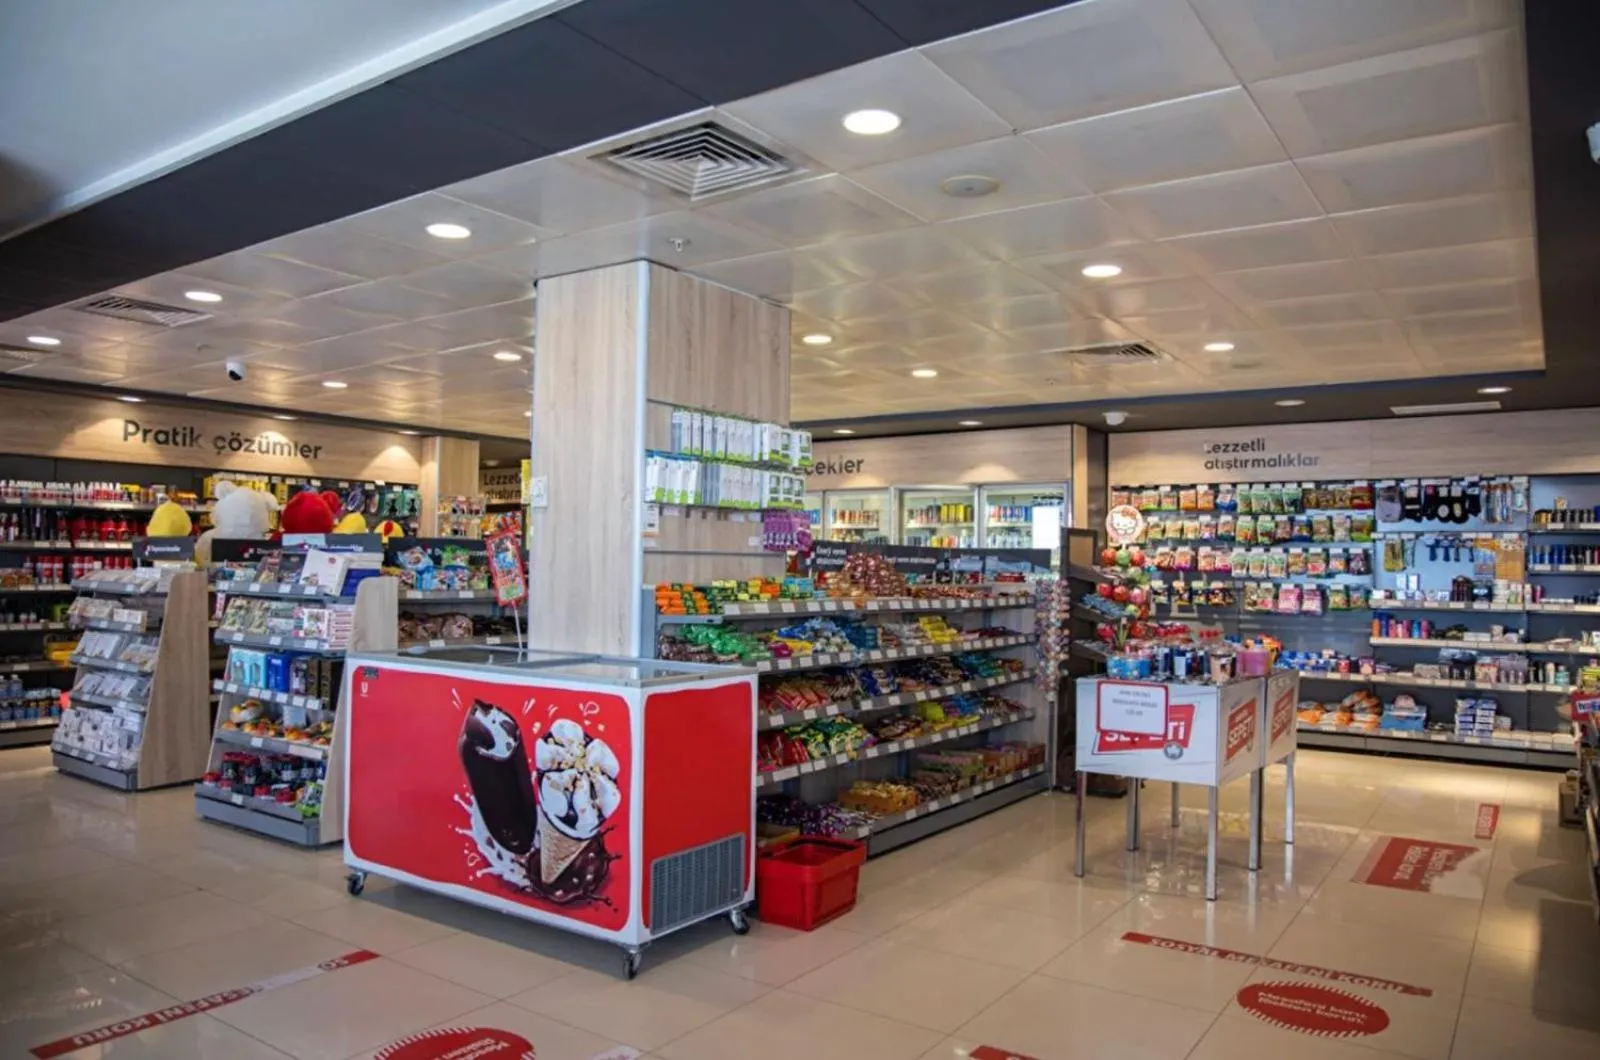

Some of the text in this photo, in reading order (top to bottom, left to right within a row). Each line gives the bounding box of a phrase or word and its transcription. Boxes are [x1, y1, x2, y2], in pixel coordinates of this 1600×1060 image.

[123, 419, 323, 460] Pratik çözümler
[1203, 453, 1321, 471] atıştırmalıklar
[1151, 937, 1219, 958] SOSYAL
